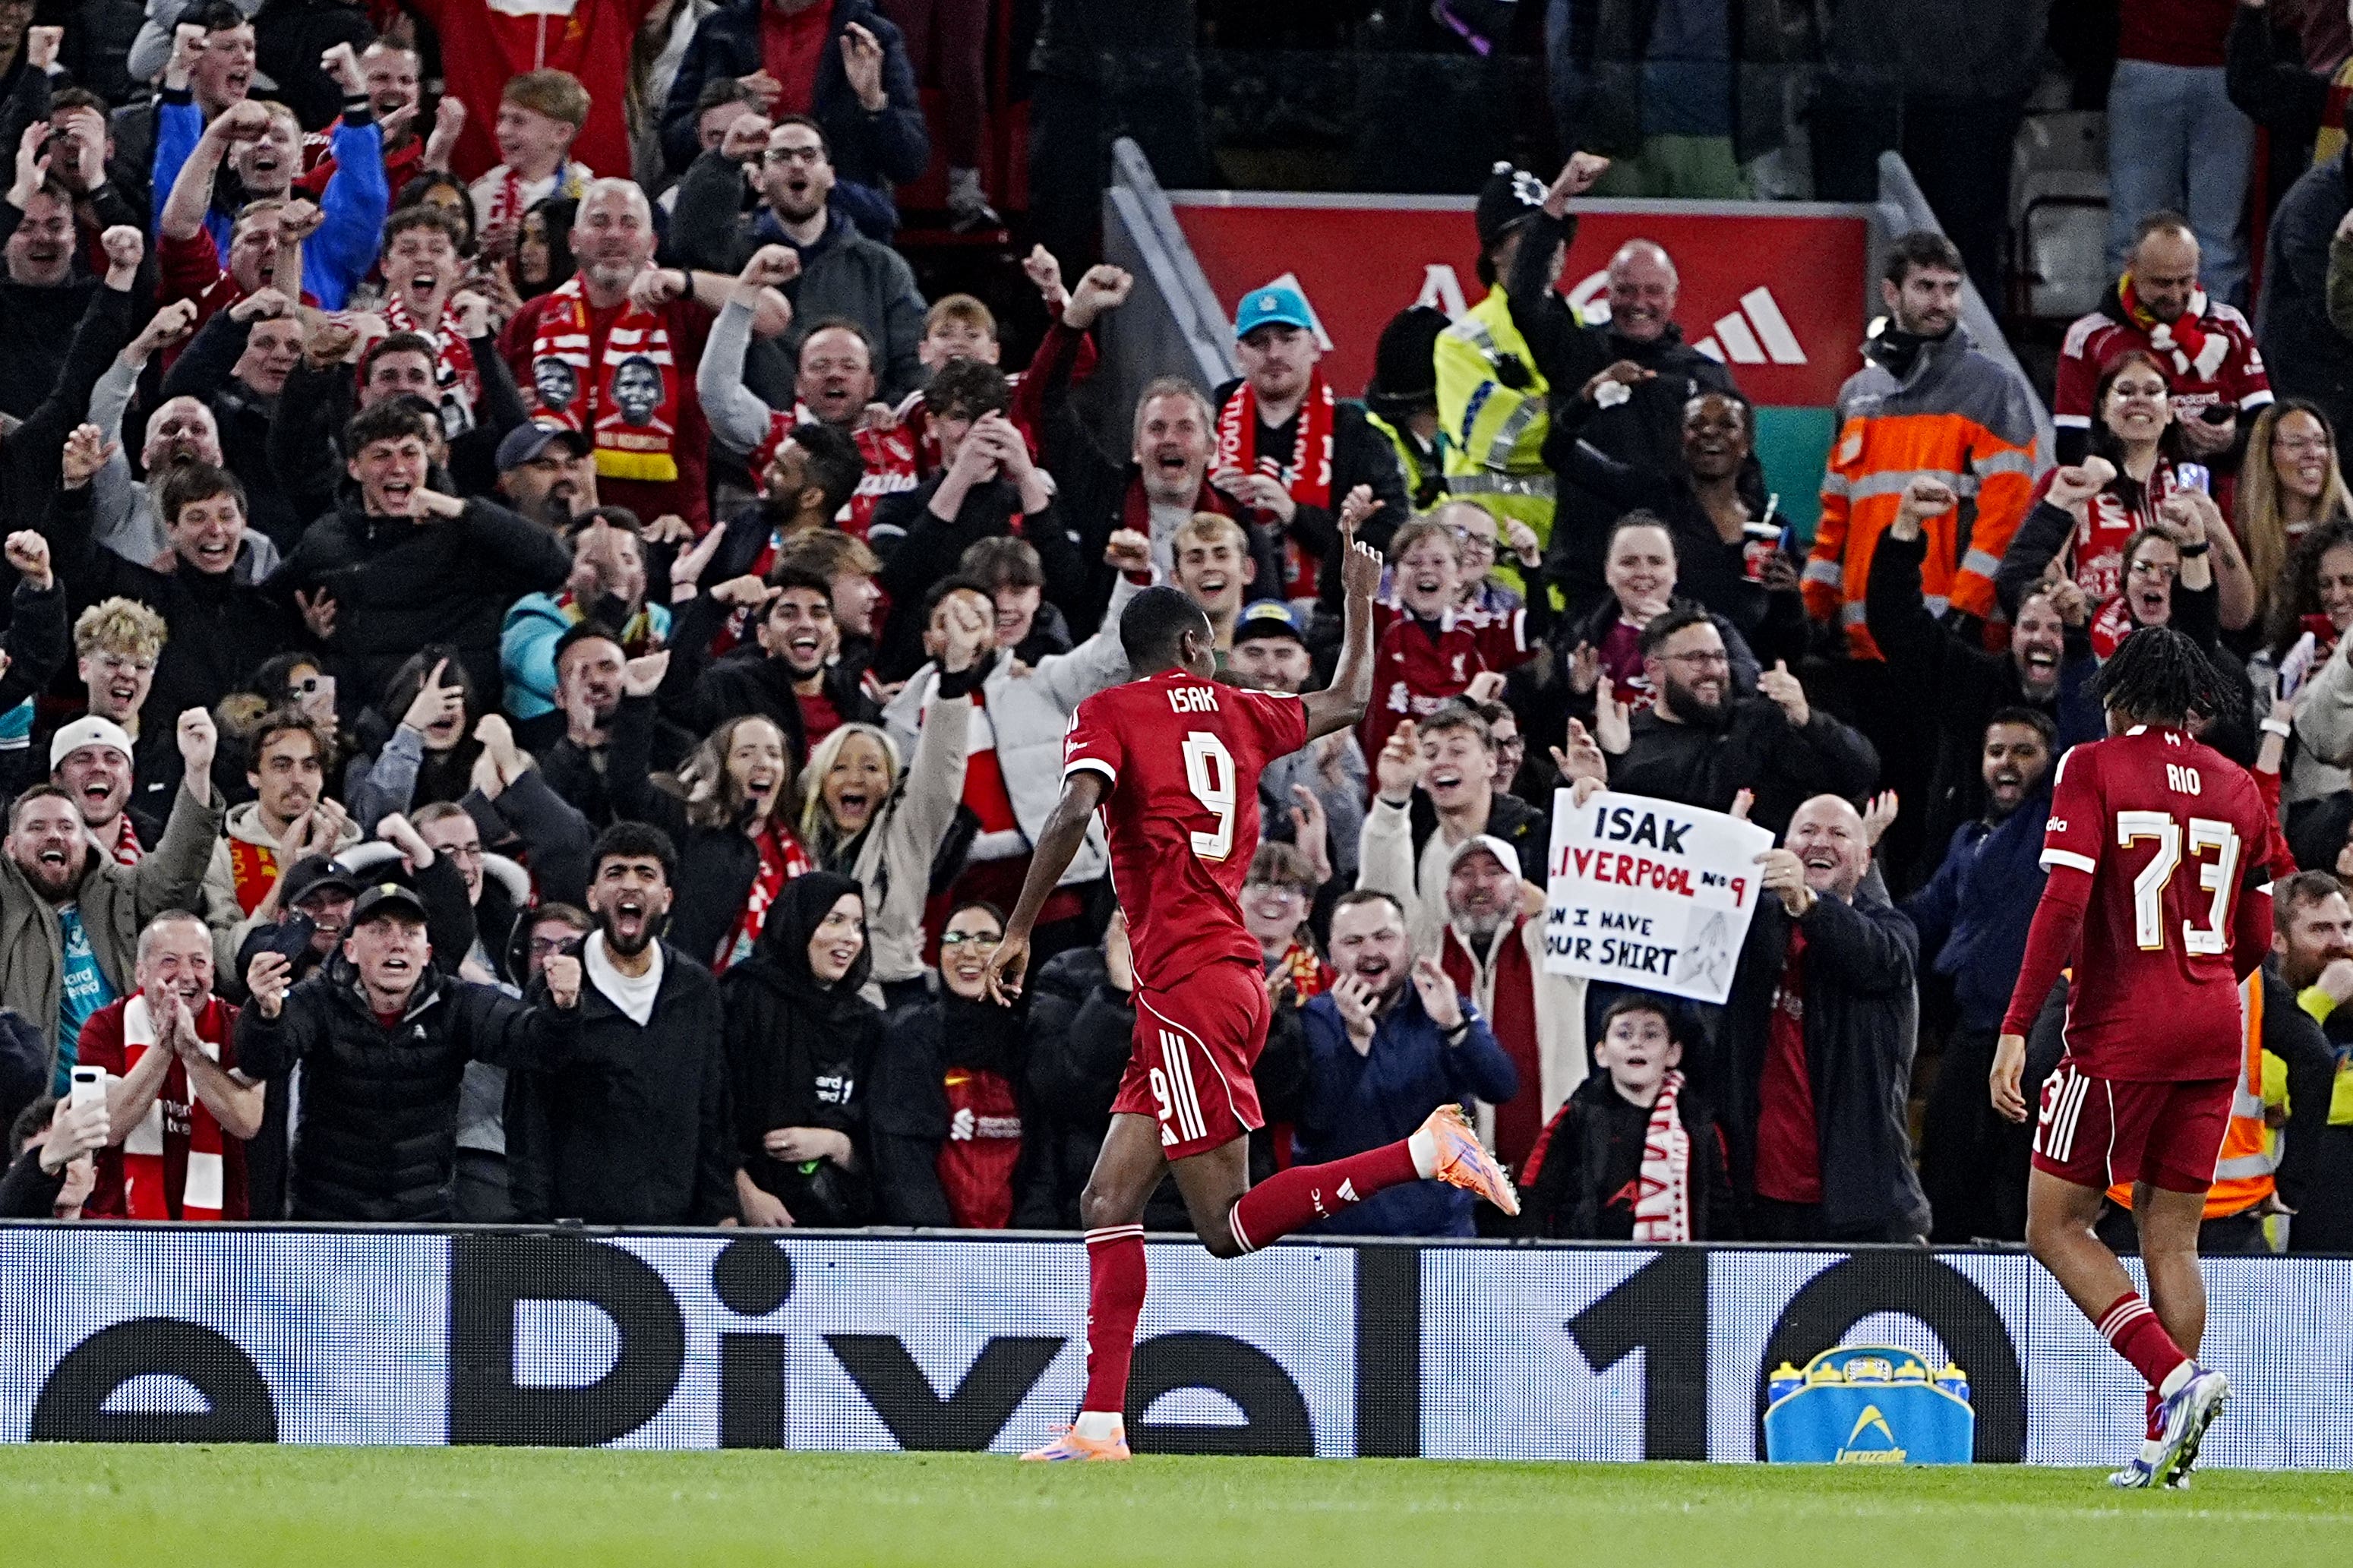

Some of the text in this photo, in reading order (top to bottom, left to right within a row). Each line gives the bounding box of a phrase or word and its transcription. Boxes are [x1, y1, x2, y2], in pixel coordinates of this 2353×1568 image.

[1167, 686, 1219, 713] ISAK
[1182, 730, 1236, 862] 9
[2165, 762, 2201, 796] RIO
[1593, 806, 1693, 854] ISAK
[1551, 846, 1694, 898] IVERPOOL
[2117, 810, 2241, 957] 73
[1573, 910, 1589, 926] I
[1600, 910, 1653, 936] HAVE
[1599, 939, 1677, 976] SHIRT
[1149, 1067, 1173, 1122] 9
